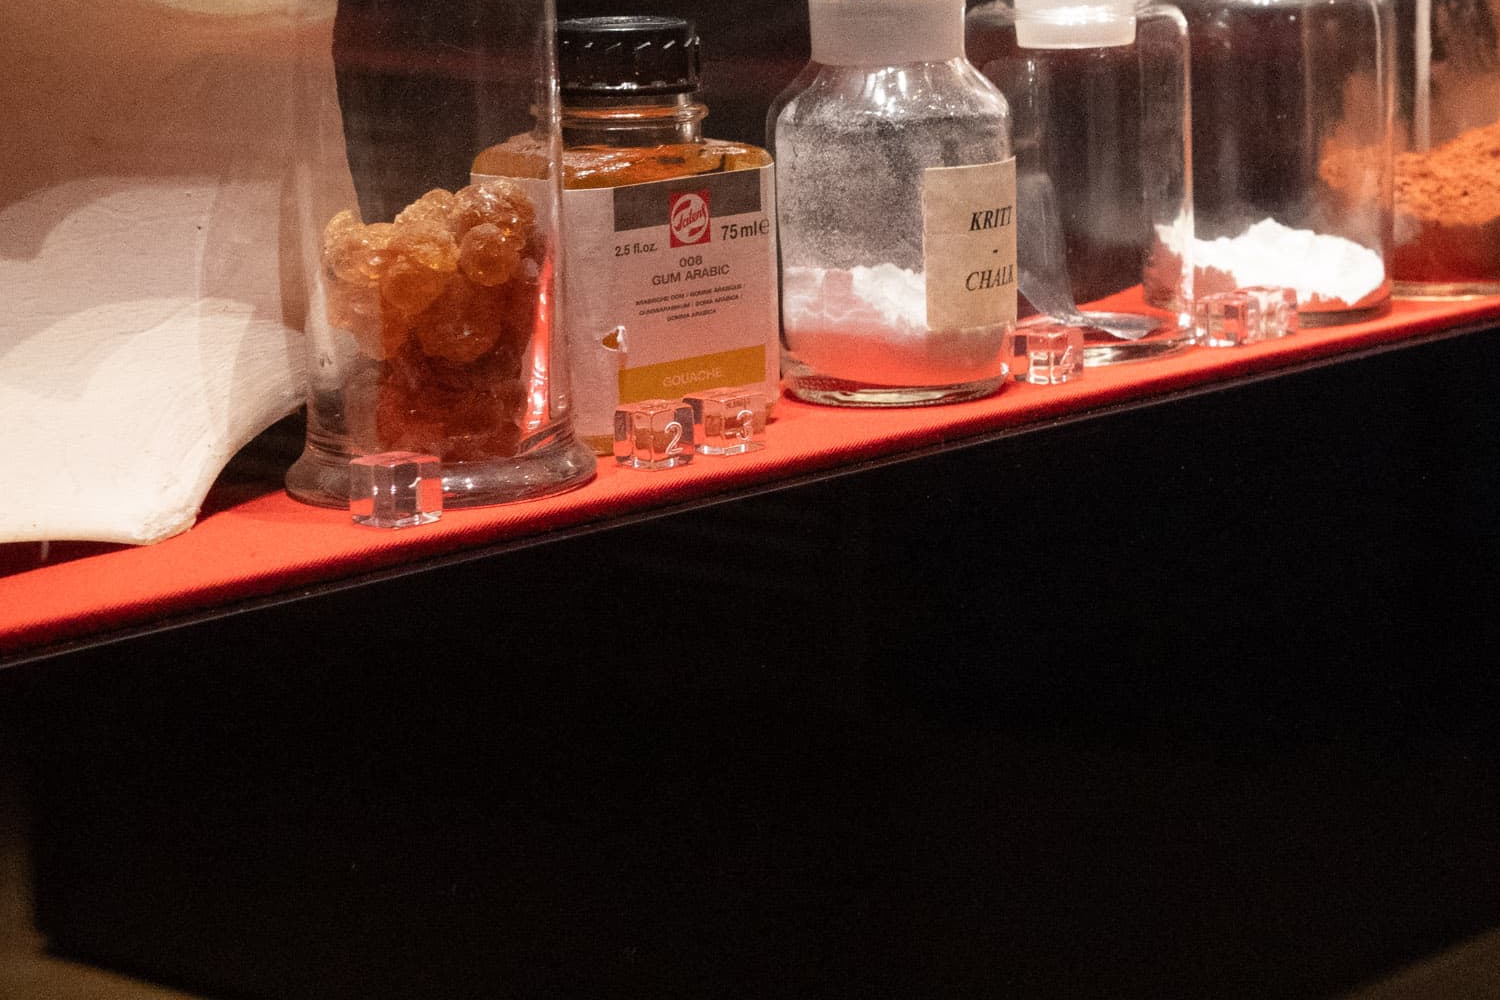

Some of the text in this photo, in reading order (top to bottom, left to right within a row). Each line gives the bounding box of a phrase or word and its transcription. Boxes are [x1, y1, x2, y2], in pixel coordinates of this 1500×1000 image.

[720, 223, 738, 242] 75
[614, 244, 631, 258] 2.5
[678, 254, 704, 268] 008
[651, 264, 731, 287] GUM ARABIC
[662, 367, 722, 388] GOUACHE
[735, 409, 754, 442] 3
[663, 420, 685, 456] 2
